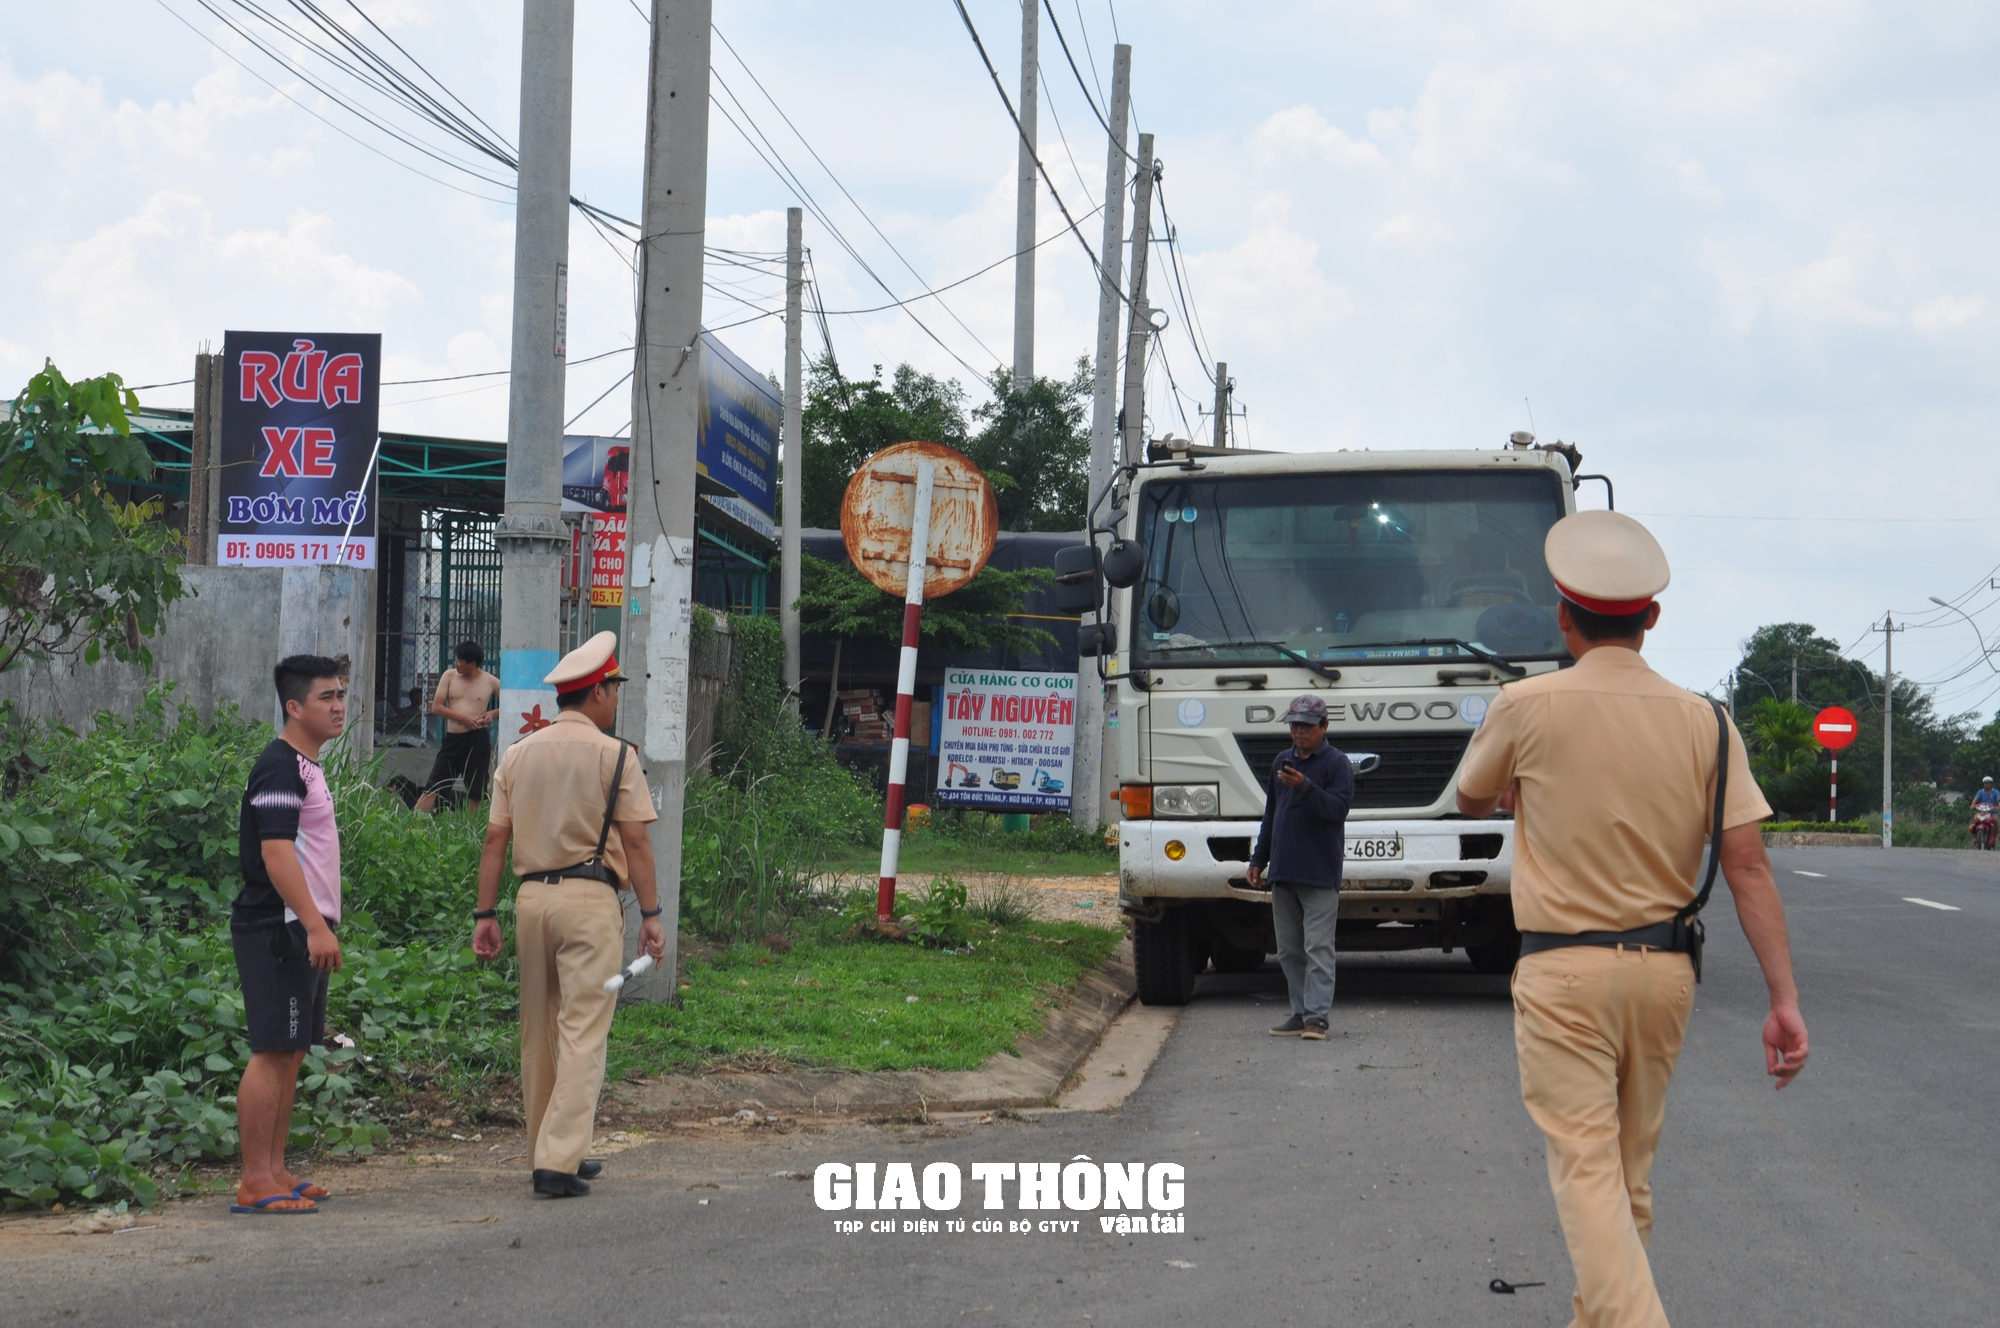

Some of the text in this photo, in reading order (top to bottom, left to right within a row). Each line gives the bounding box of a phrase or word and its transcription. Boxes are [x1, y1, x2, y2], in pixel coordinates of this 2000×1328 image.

[239, 339, 364, 409] RỬA
[259, 426, 336, 479] XE
[228, 492, 305, 524] BƠM
[226, 541, 251, 559] ĐT:
[255, 542, 296, 560] 0905
[301, 543, 329, 560] 171
[599, 557, 622, 570] CHO
[592, 591, 623, 603] 05.17
[949, 670, 1074, 689] CỬA HÀNG CƠ GIỚI
[946, 688, 986, 721] TÂY
[990, 692, 1075, 726] NGUYÊN
[1245, 701, 1458, 724] DEWOO
[962, 726, 1055, 741] HOTLINE: 0981. 002 772
[943, 740, 964, 750] CHUYÊN
[965, 742, 977, 751] MUA
[977, 740, 989, 751] BÁN
[988, 743, 1000, 754] PHỤ
[1000, 742, 1014, 753] TÙNG
[1017, 742, 1029, 754] SỬA
[1044, 746, 1051, 755] XE
[1051, 746, 1060, 755] CƠ
[947, 753, 974, 763] KOBELCO
[978, 755, 1006, 765] KOMATSU
[1011, 757, 1034, 766] HITACHI
[1038, 758, 1063, 768] DOOSAN
[1344, 839, 1398, 858] -4683
[289, 996, 299, 1039] adidas
